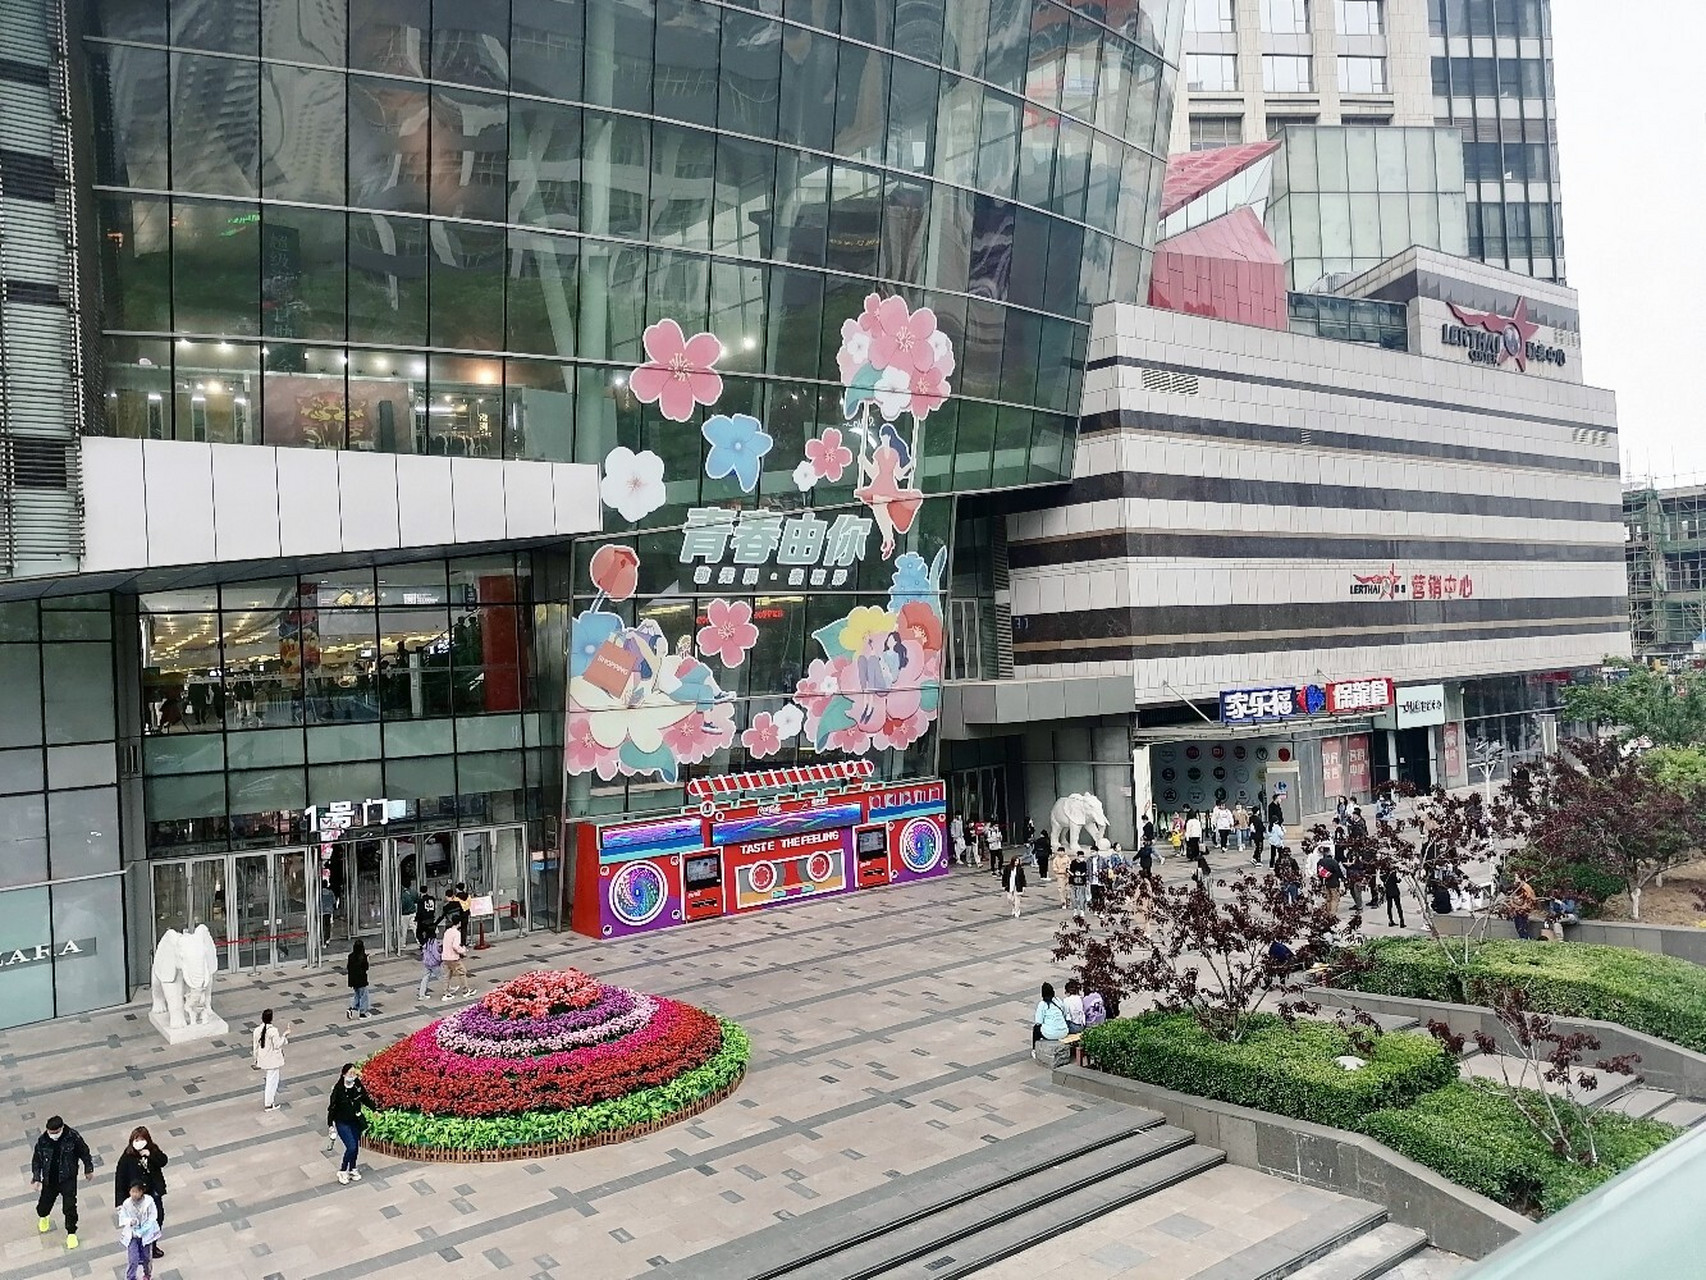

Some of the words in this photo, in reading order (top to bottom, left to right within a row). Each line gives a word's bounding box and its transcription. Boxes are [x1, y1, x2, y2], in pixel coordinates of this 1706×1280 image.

[1441, 323, 1500, 353] LERTHAI
[680, 507, 873, 566] 青春由你
[1350, 584, 1380, 594] LERTHAI
[1412, 573, 1473, 599] 营销中心
[1225, 690, 1293, 719] 家乐福
[304, 799, 388, 832] 1号门
[740, 841, 775, 855] TASTE
[0, 940, 83, 967] ARA
